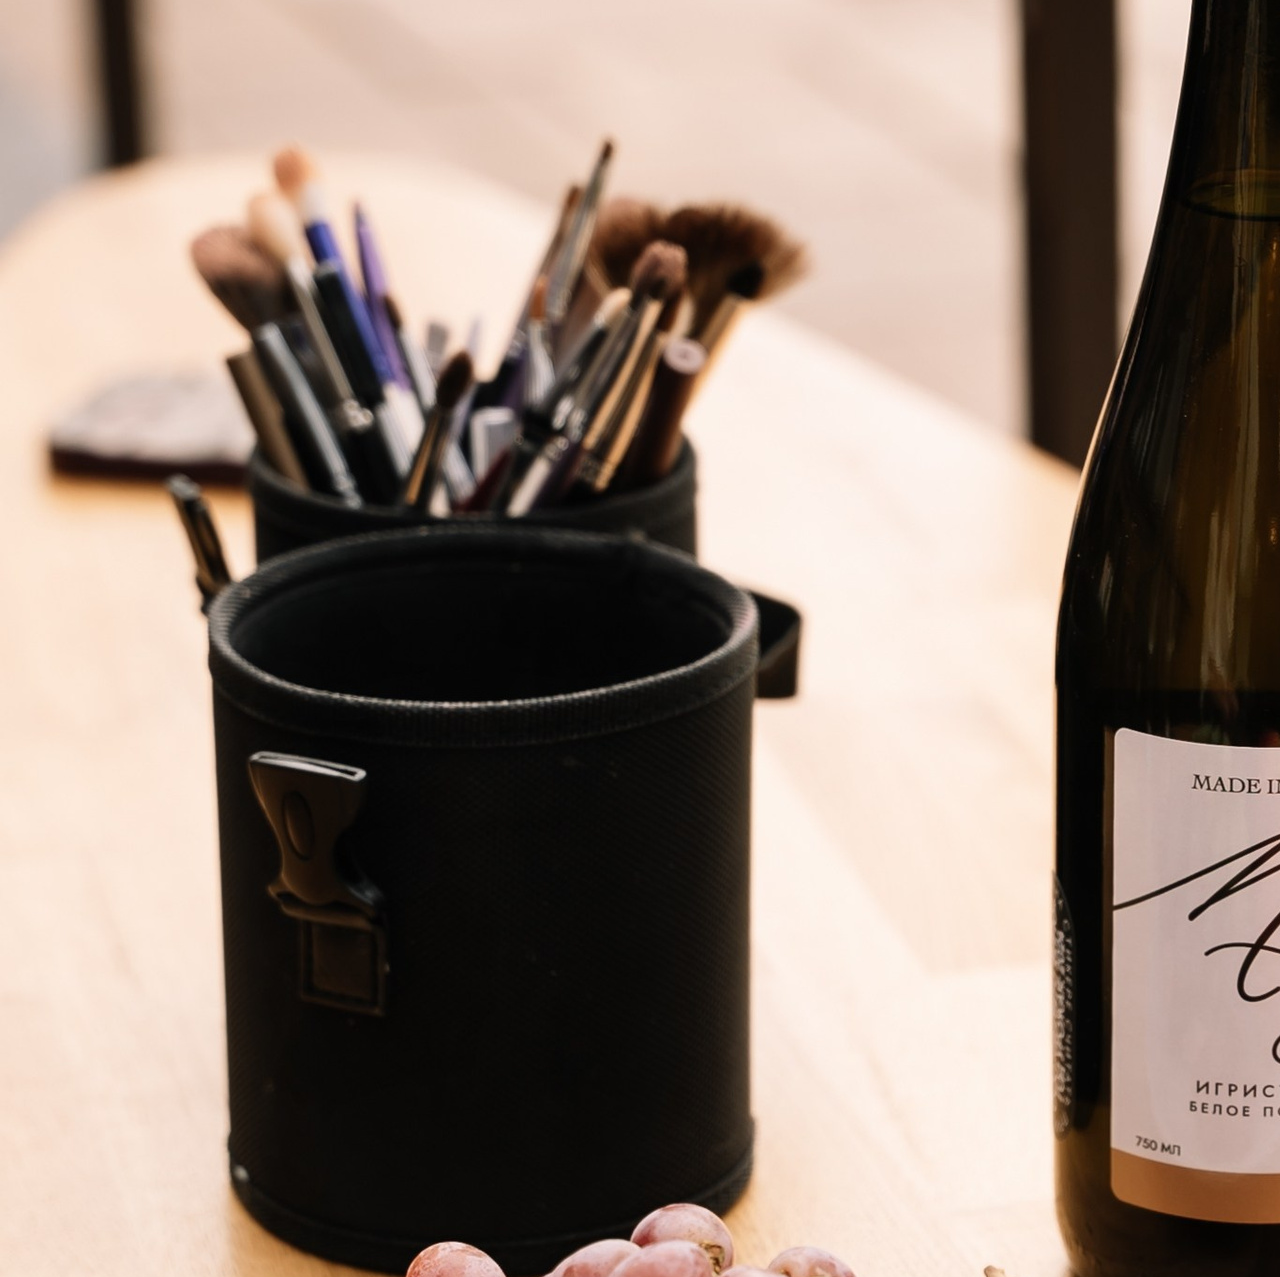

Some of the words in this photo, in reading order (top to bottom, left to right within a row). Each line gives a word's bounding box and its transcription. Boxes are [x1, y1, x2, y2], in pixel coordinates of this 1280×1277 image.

[1191, 774, 1262, 794] MADE
[1189, 1101, 1250, 1117] БЕЛОЕ
[1135, 1135, 1158, 1151] 750
